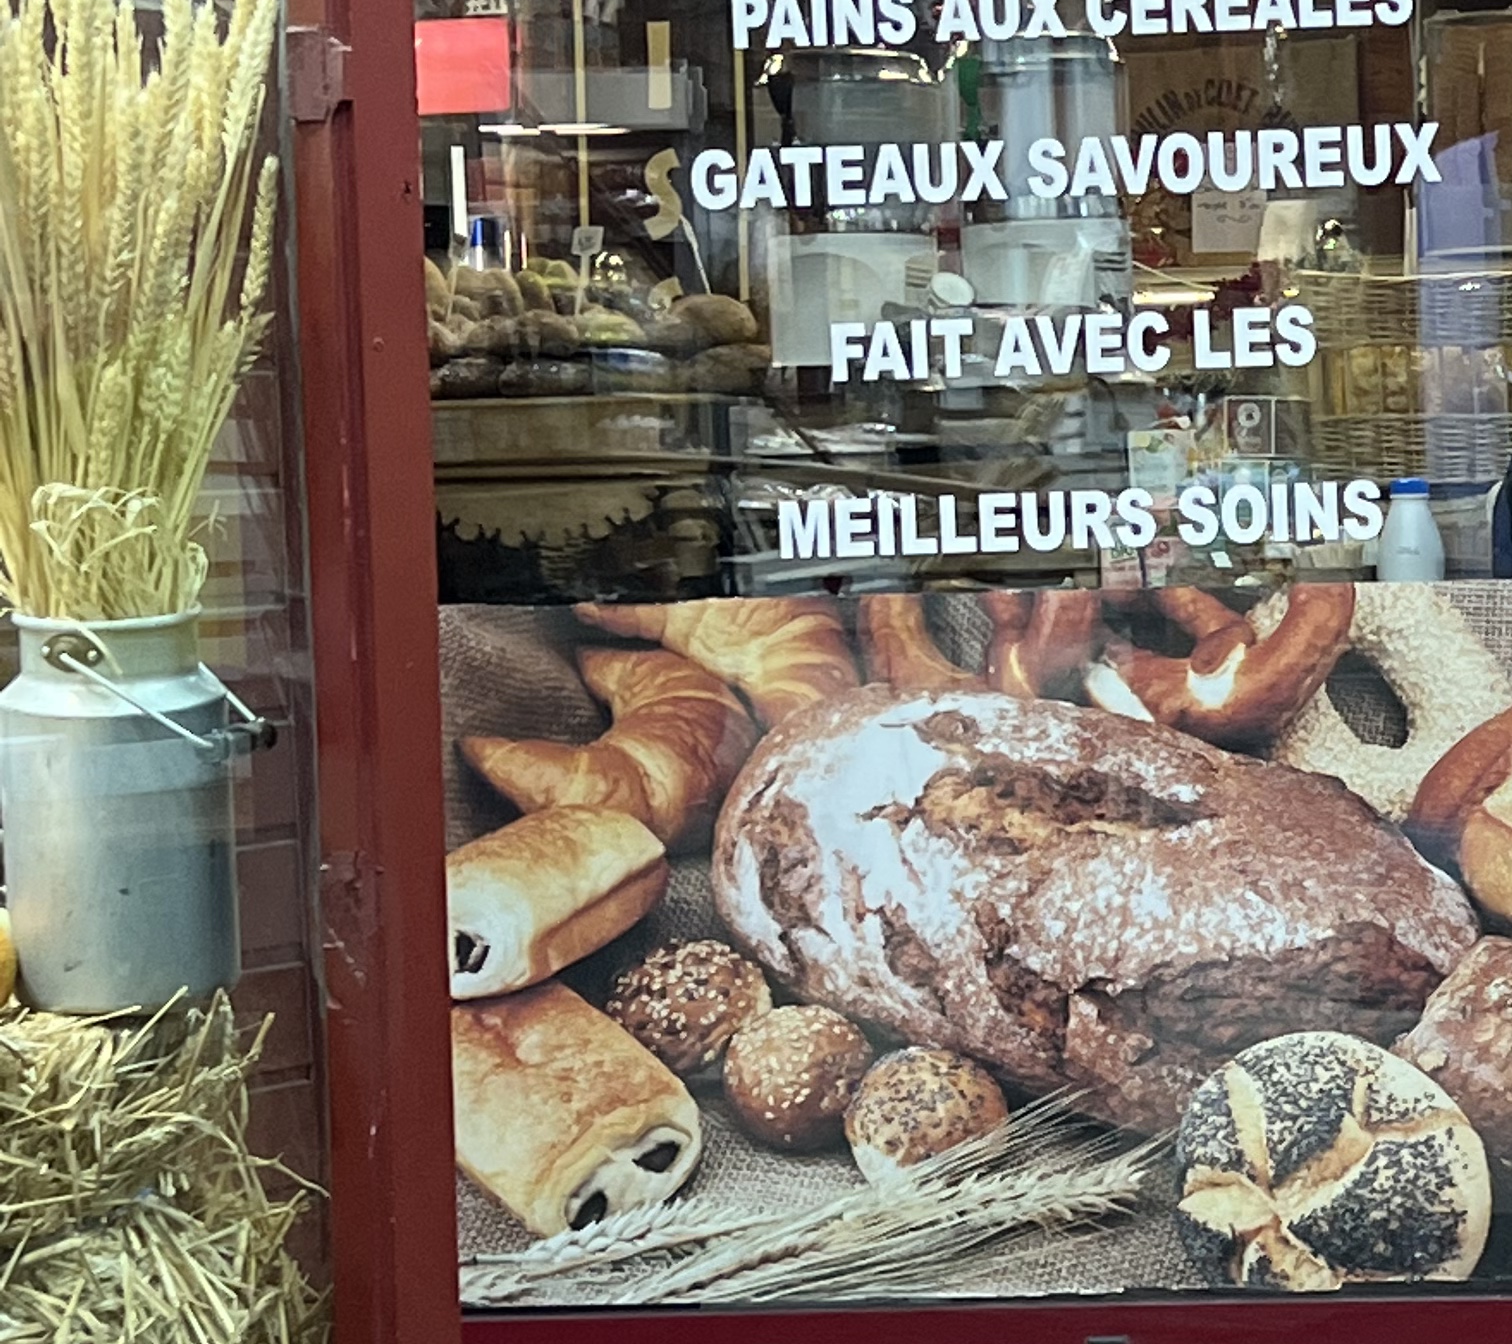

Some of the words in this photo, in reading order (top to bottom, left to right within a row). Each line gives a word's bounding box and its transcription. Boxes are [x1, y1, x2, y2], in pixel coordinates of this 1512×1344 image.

[692, 140, 1009, 209] GATEAUX
[1028, 123, 1442, 198] SAVOUREUX
[831, 318, 973, 381] FAIT
[995, 311, 1171, 378] AVEC
[1194, 306, 1317, 369] LES
[778, 487, 1157, 559] MEILLEURS
[1178, 479, 1384, 547] SOINS
